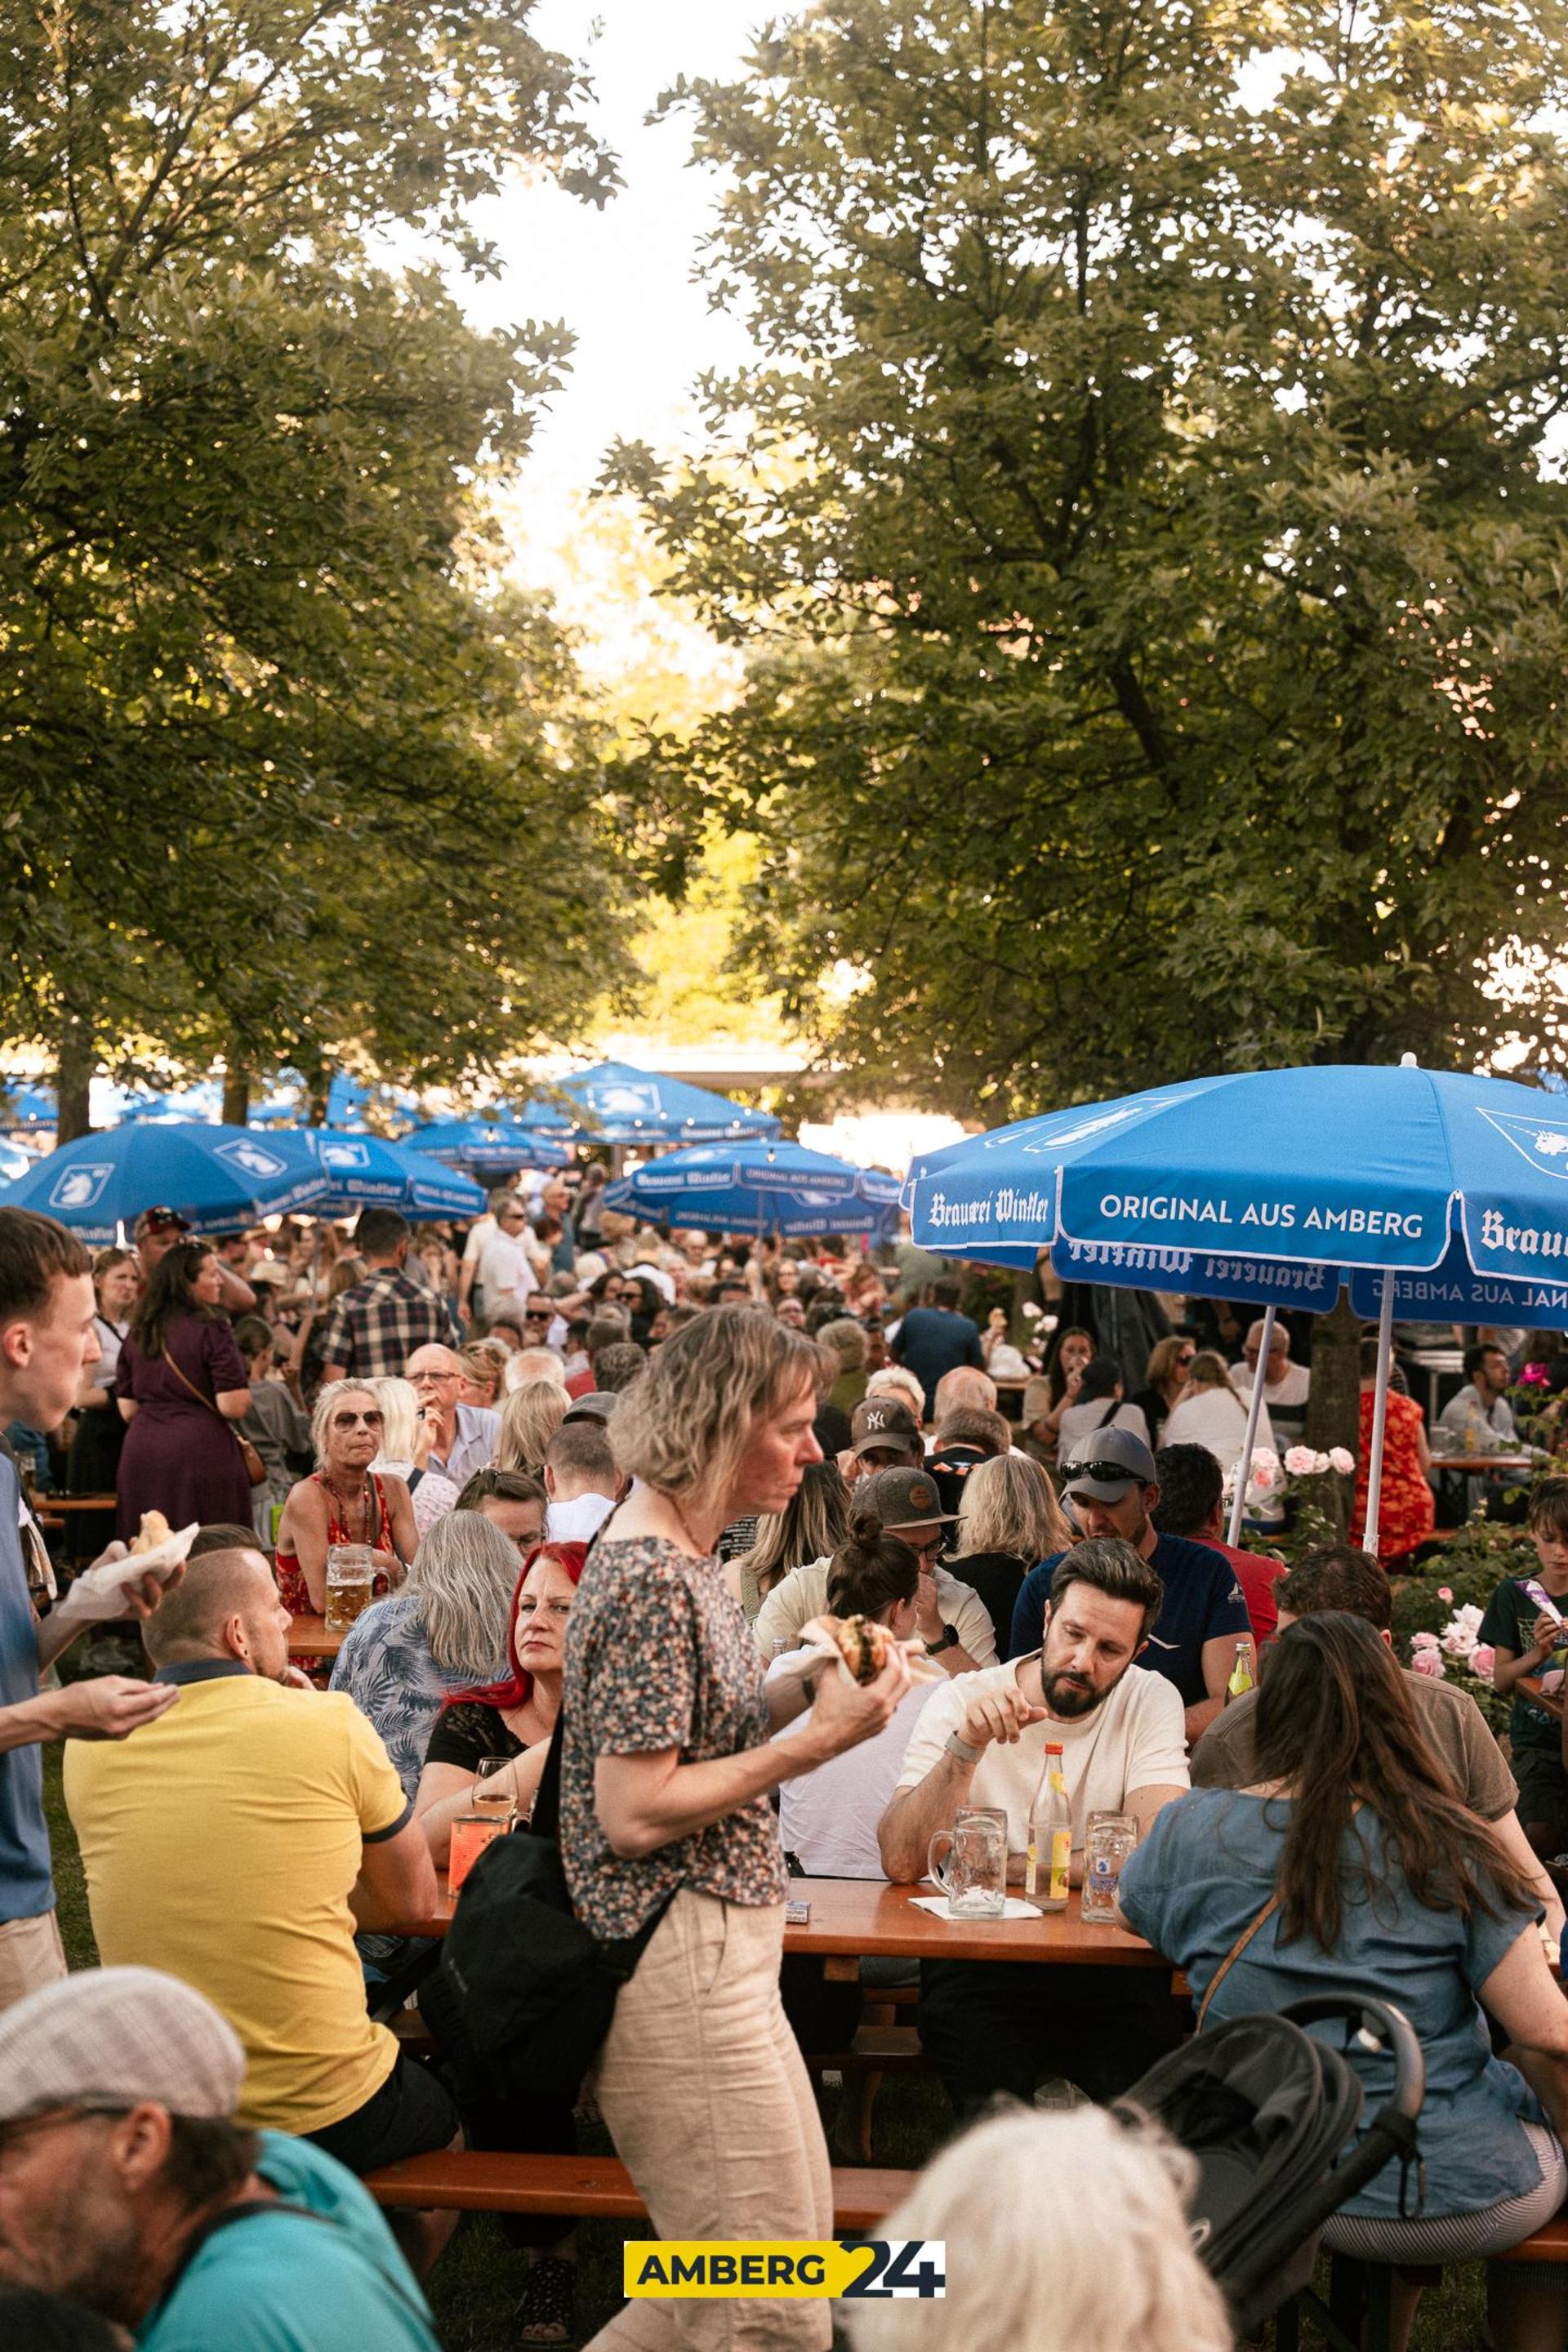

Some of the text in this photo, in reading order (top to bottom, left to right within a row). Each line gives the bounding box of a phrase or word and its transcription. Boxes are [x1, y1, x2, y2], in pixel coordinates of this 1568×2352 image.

[928, 1190, 994, 1227] Brauerei
[1100, 1194, 1423, 1238] ORIGINAL AUS AMBERG
[1481, 1209, 1568, 1258] Brau
[866, 1410, 886, 1430] NY
